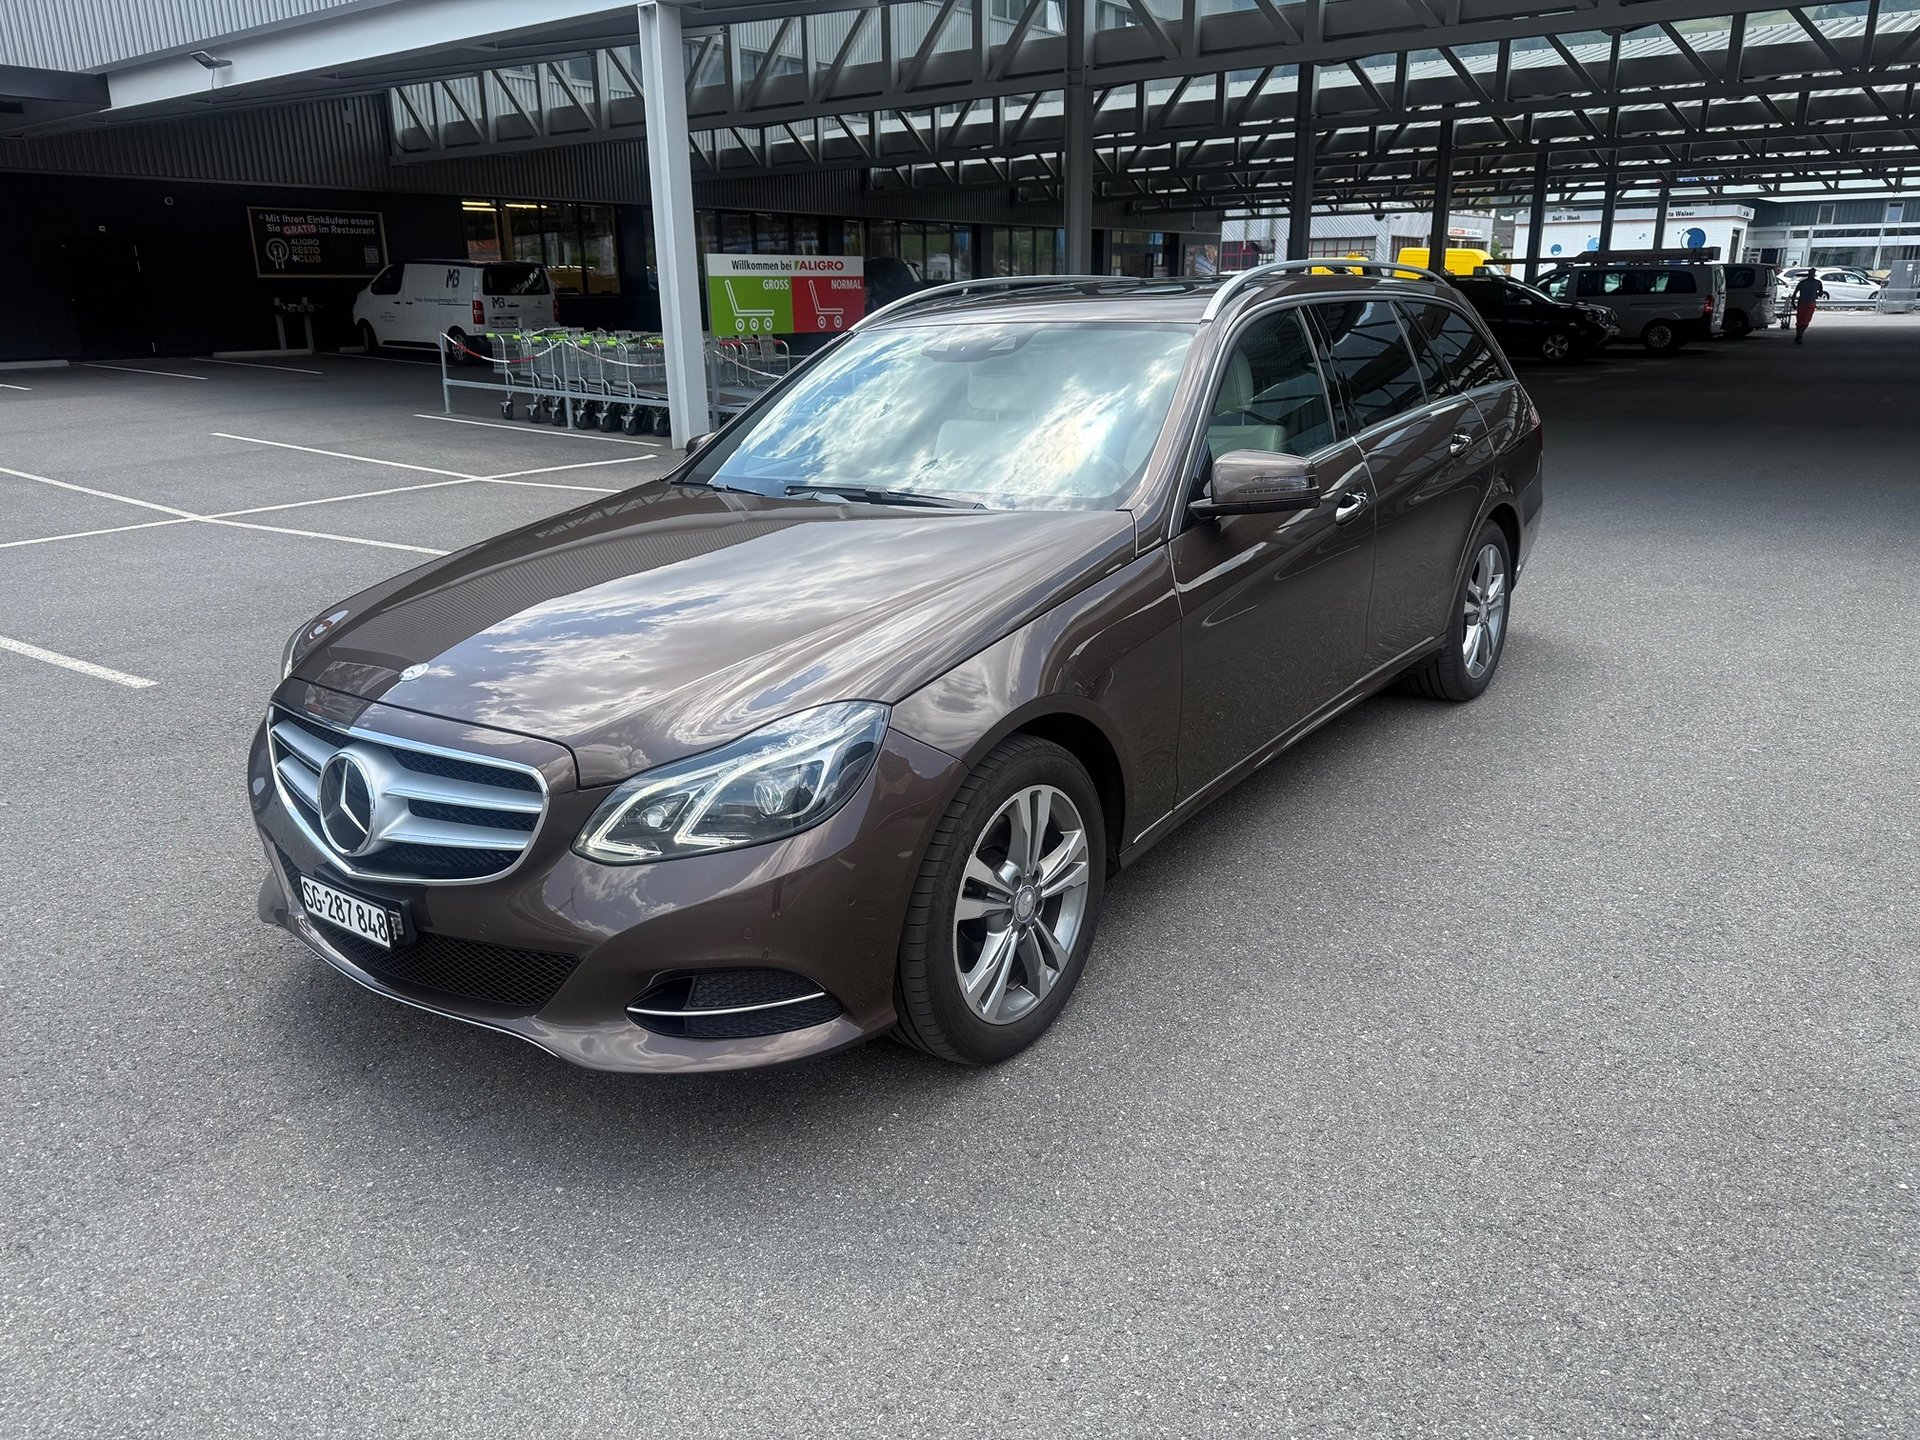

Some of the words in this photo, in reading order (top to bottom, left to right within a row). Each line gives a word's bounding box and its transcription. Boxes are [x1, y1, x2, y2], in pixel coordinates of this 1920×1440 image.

[265, 214, 280, 223] Mit
[282, 214, 305, 223] Ihren
[307, 215, 349, 225] Einkäufen
[350, 218, 375, 226] essen
[266, 223, 281, 232] Sie
[283, 224, 317, 235] GRATIS
[318, 225, 329, 233] im
[331, 226, 375, 235] Restaurant
[290, 238, 320, 246] ALIGRO
[291, 246, 320, 254] RESTO
[298, 255, 322, 263] CLUB
[731, 259, 779, 271] Willkommen
[780, 259, 792, 271] bei
[798, 260, 844, 271] ALIGRO
[763, 279, 789, 290] GROSS
[831, 279, 862, 290] NORMAL
[355, 904, 388, 943] 848
